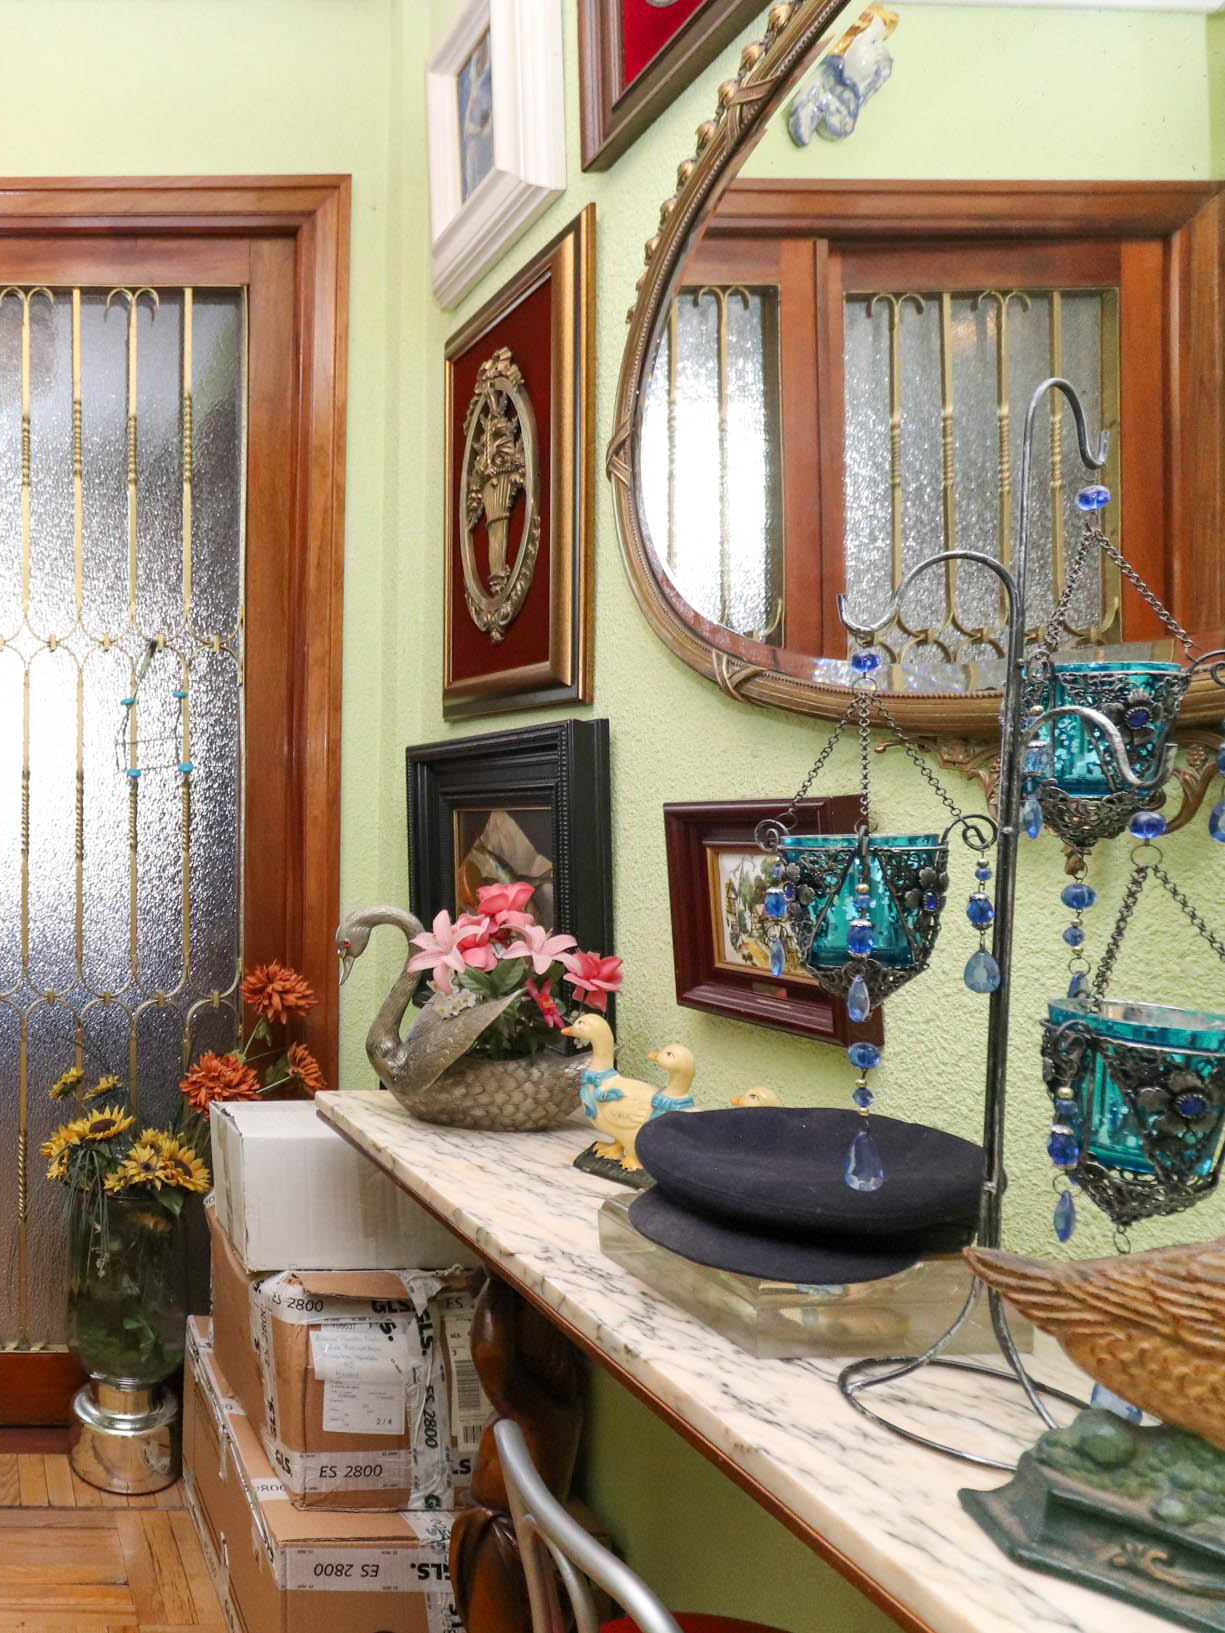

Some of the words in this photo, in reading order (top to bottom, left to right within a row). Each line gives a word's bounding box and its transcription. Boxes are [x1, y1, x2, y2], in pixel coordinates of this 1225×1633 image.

[287, 1297, 324, 1312] 2800
[446, 1298, 463, 1309] ES
[423, 1408, 439, 1448] 2800
[319, 1465, 337, 1478] ES
[343, 1464, 383, 1478] 2800
[313, 1563, 354, 1577] 2800
[360, 1563, 380, 1577] ES
